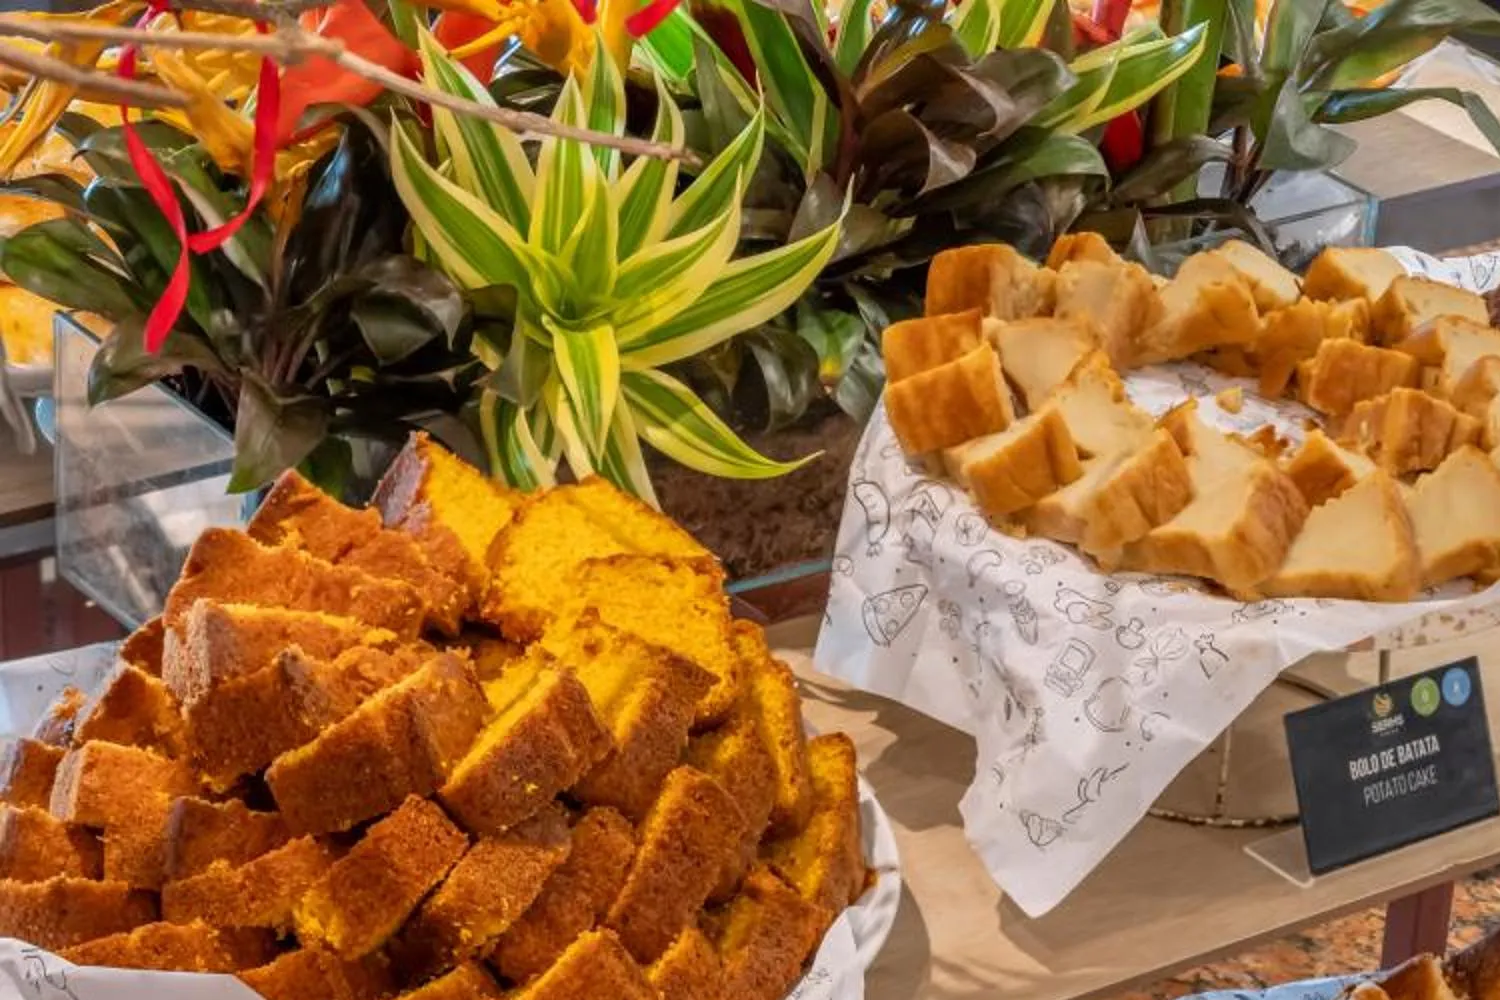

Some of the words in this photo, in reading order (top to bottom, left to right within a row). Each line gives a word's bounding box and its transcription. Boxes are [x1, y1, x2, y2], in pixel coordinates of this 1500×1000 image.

[1350, 753, 1380, 780] BOLO
[1381, 749, 1396, 770] DE
[1397, 735, 1440, 764] BATATA
[1363, 775, 1408, 807] POTATO
[1407, 764, 1438, 793] CAKE
